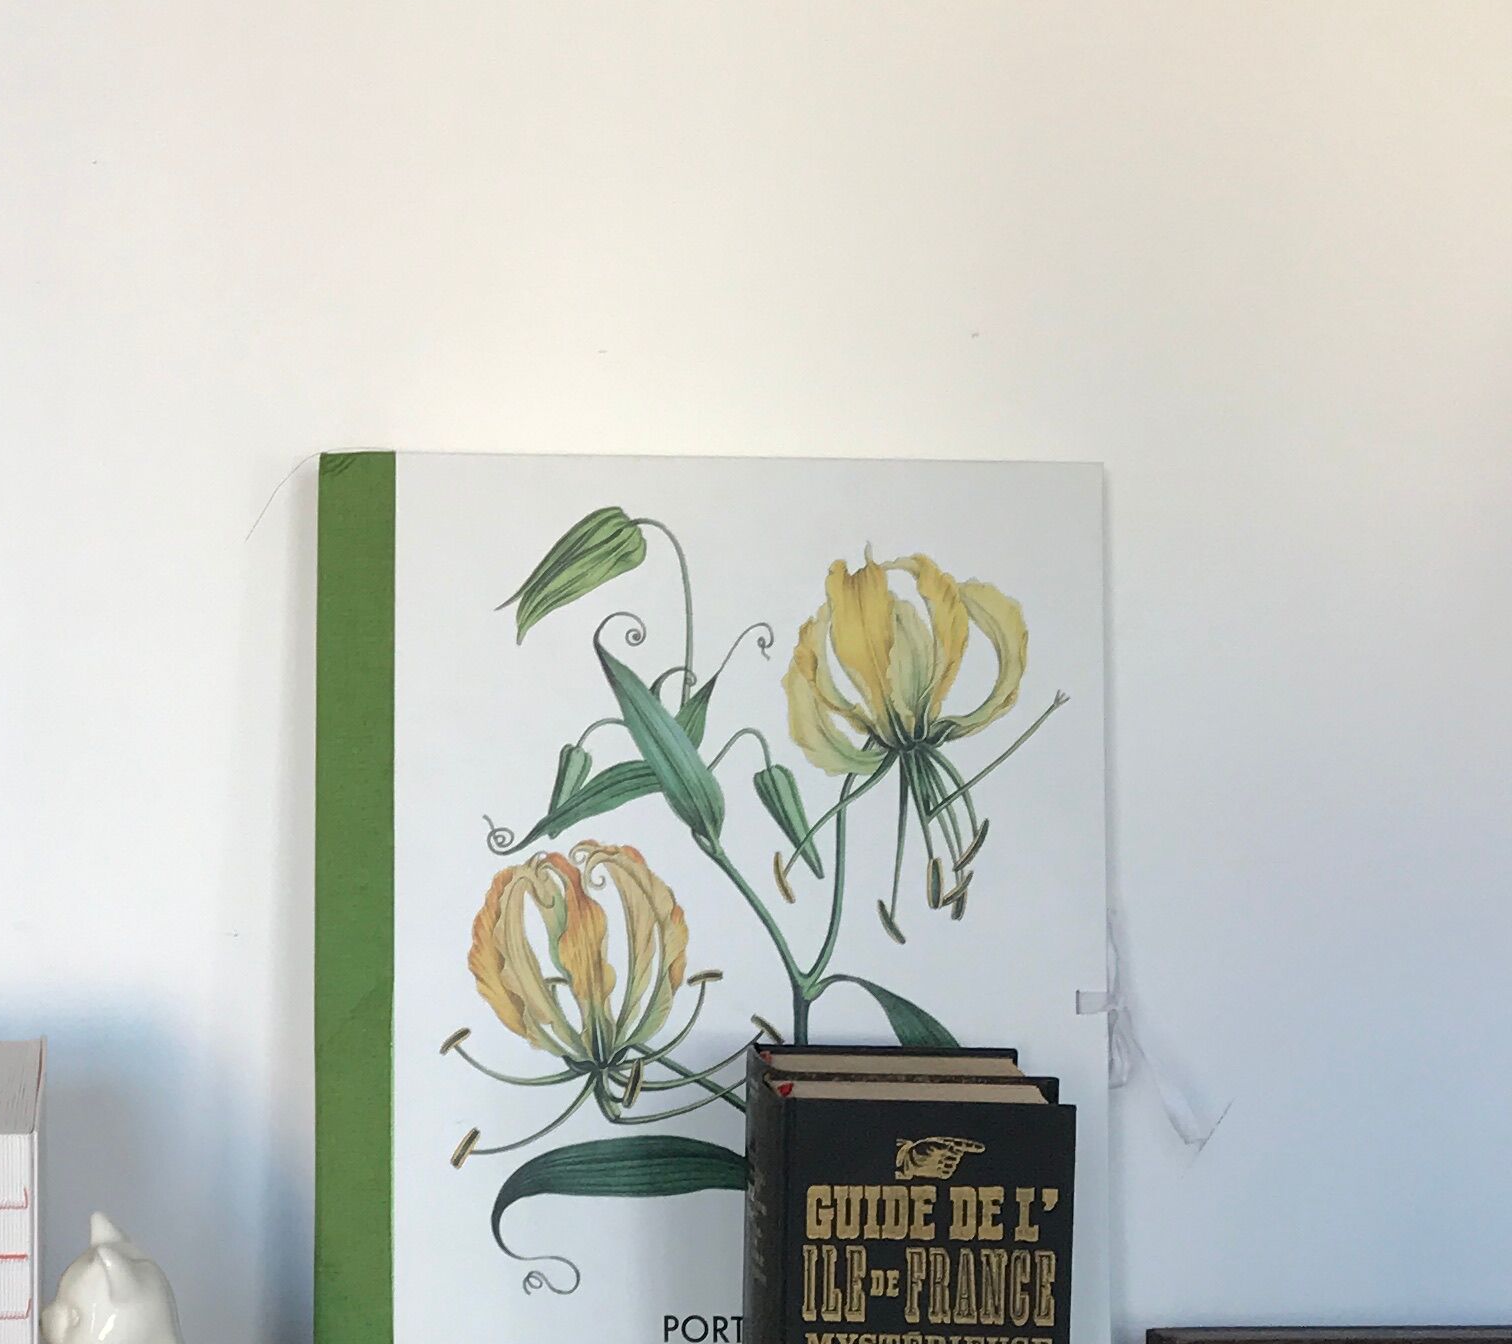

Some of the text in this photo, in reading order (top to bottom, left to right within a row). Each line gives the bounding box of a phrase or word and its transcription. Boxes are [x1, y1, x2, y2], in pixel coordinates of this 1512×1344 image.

[806, 1184, 937, 1241] GUIDE
[949, 1186, 1005, 1241] DE
[1014, 1187, 1059, 1242] L'
[801, 1244, 1056, 1327] ILE DE FRANCE
